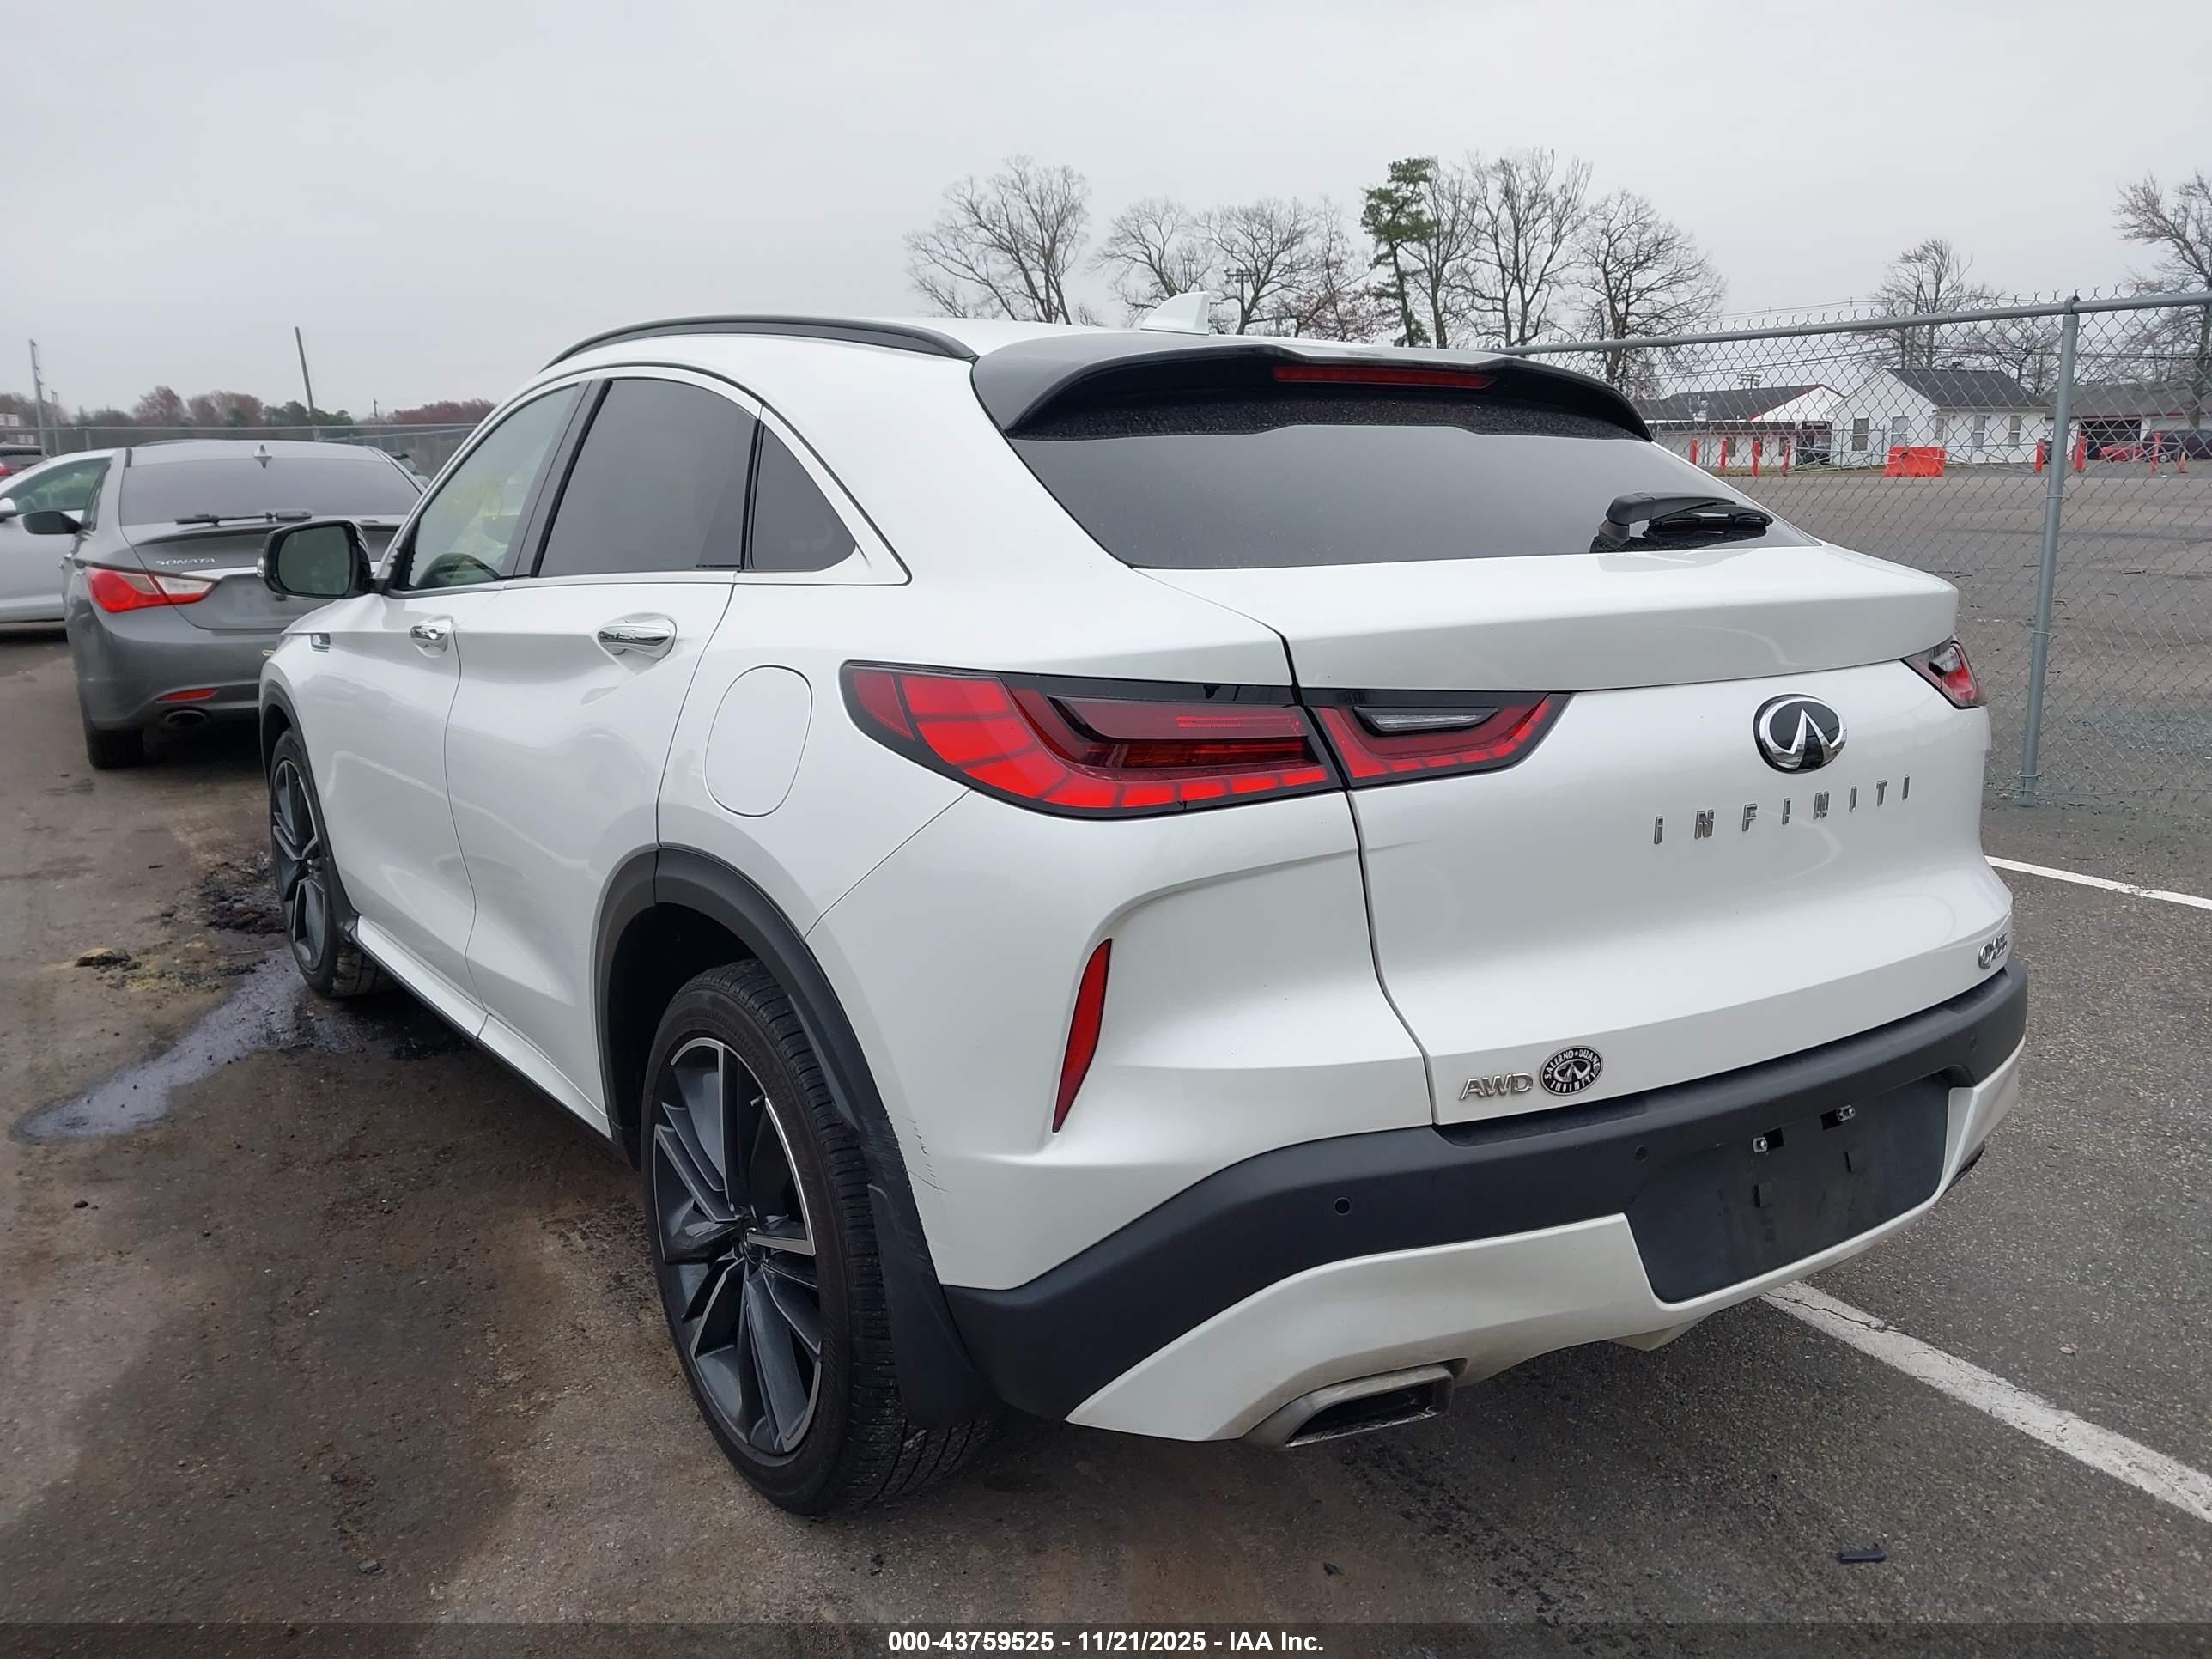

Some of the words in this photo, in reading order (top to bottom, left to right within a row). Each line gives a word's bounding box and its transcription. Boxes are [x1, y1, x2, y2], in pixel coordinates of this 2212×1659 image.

[1654, 774, 1910, 844] INFINITI
[1544, 1049, 1574, 1079] SALERNO
[1460, 1073, 1534, 1100] AWD
[1550, 1072, 1596, 1092] INFINITI
